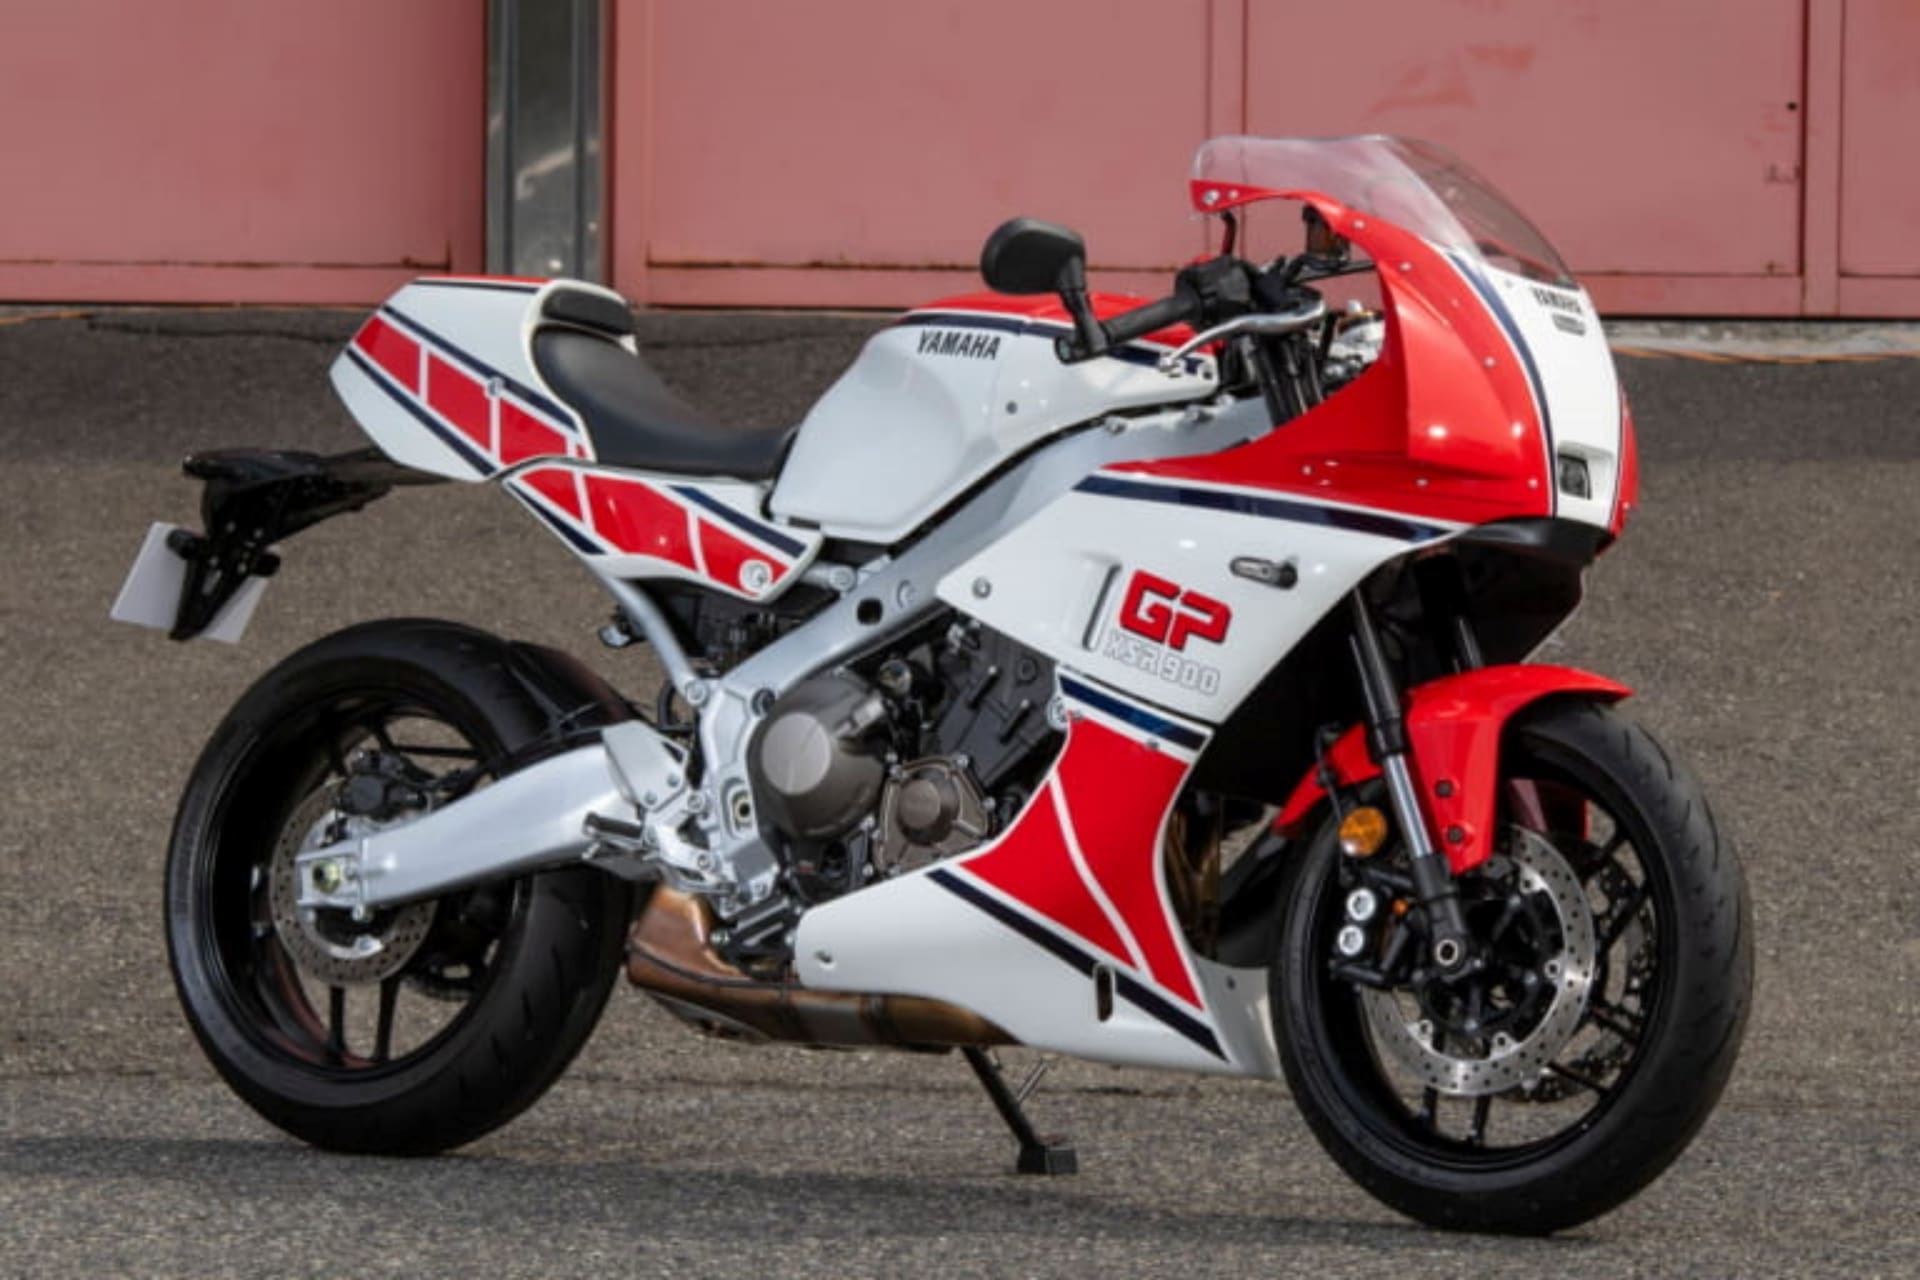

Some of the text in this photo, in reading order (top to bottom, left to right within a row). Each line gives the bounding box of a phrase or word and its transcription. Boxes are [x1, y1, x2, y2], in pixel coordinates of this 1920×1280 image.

[917, 328, 1001, 360] YAMAHA
[1119, 568, 1233, 652] GP
[1103, 628, 1221, 696] XSR900
